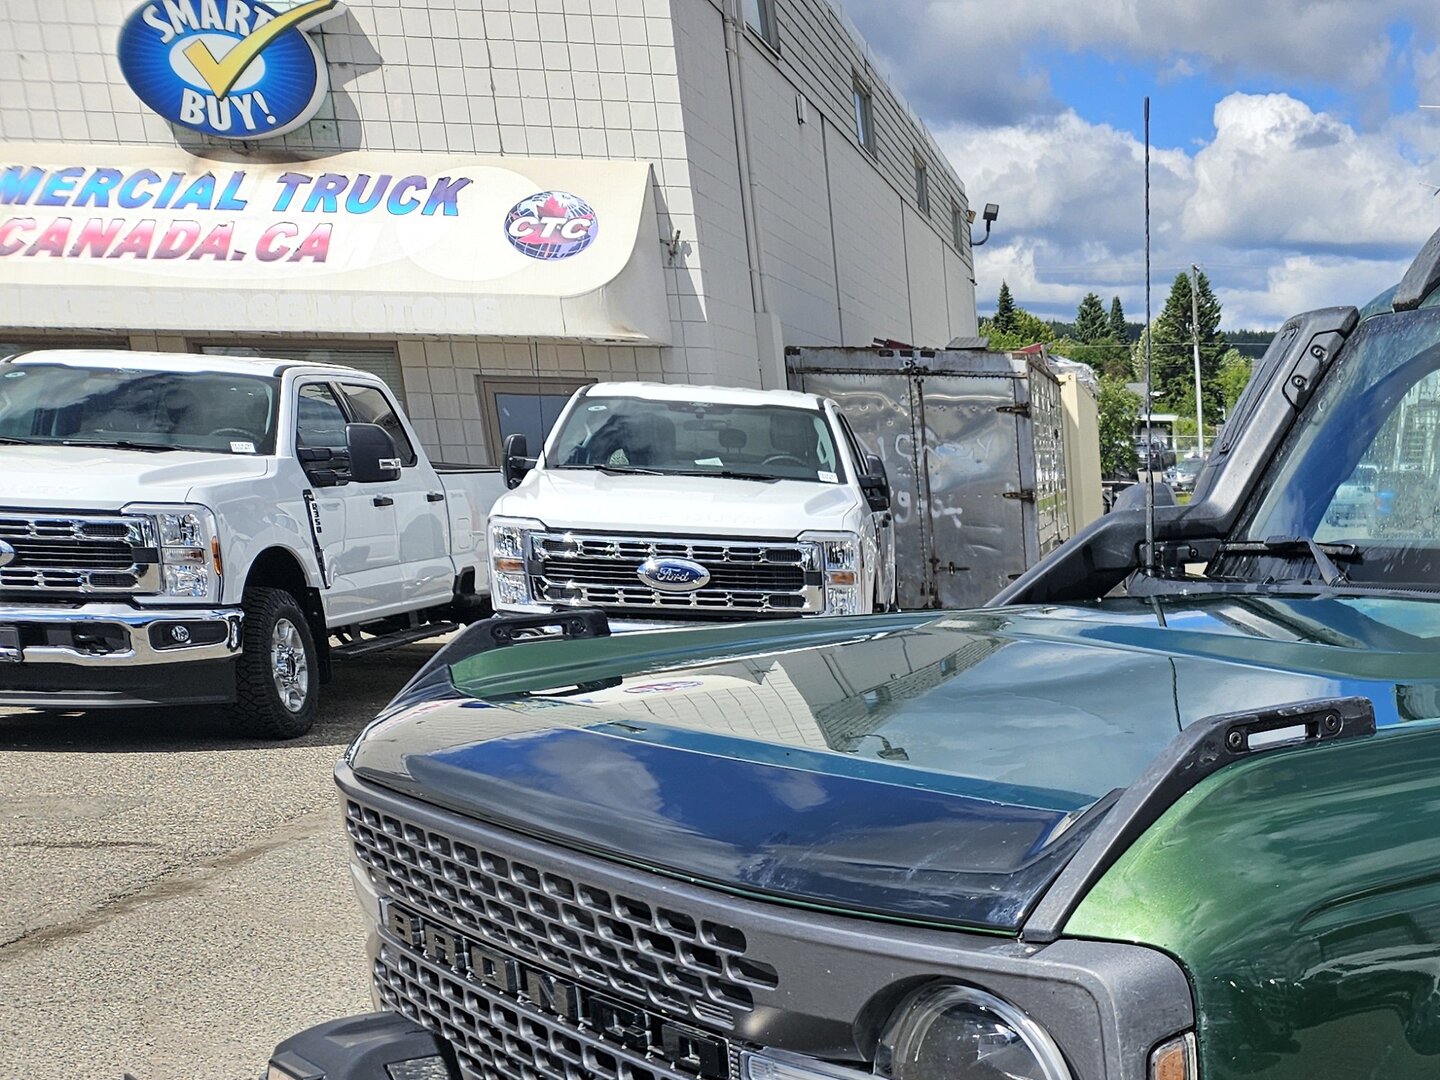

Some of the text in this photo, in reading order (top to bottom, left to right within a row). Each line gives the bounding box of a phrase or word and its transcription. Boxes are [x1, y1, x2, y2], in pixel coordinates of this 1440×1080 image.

[142, 0, 276, 44] SMART
[179, 87, 277, 131] BUY!
[272, 172, 474, 217] TRUCK
[0, 216, 334, 264] CANADA.CA
[508, 215, 592, 240] CTC
[656, 567, 690, 582] Ford
